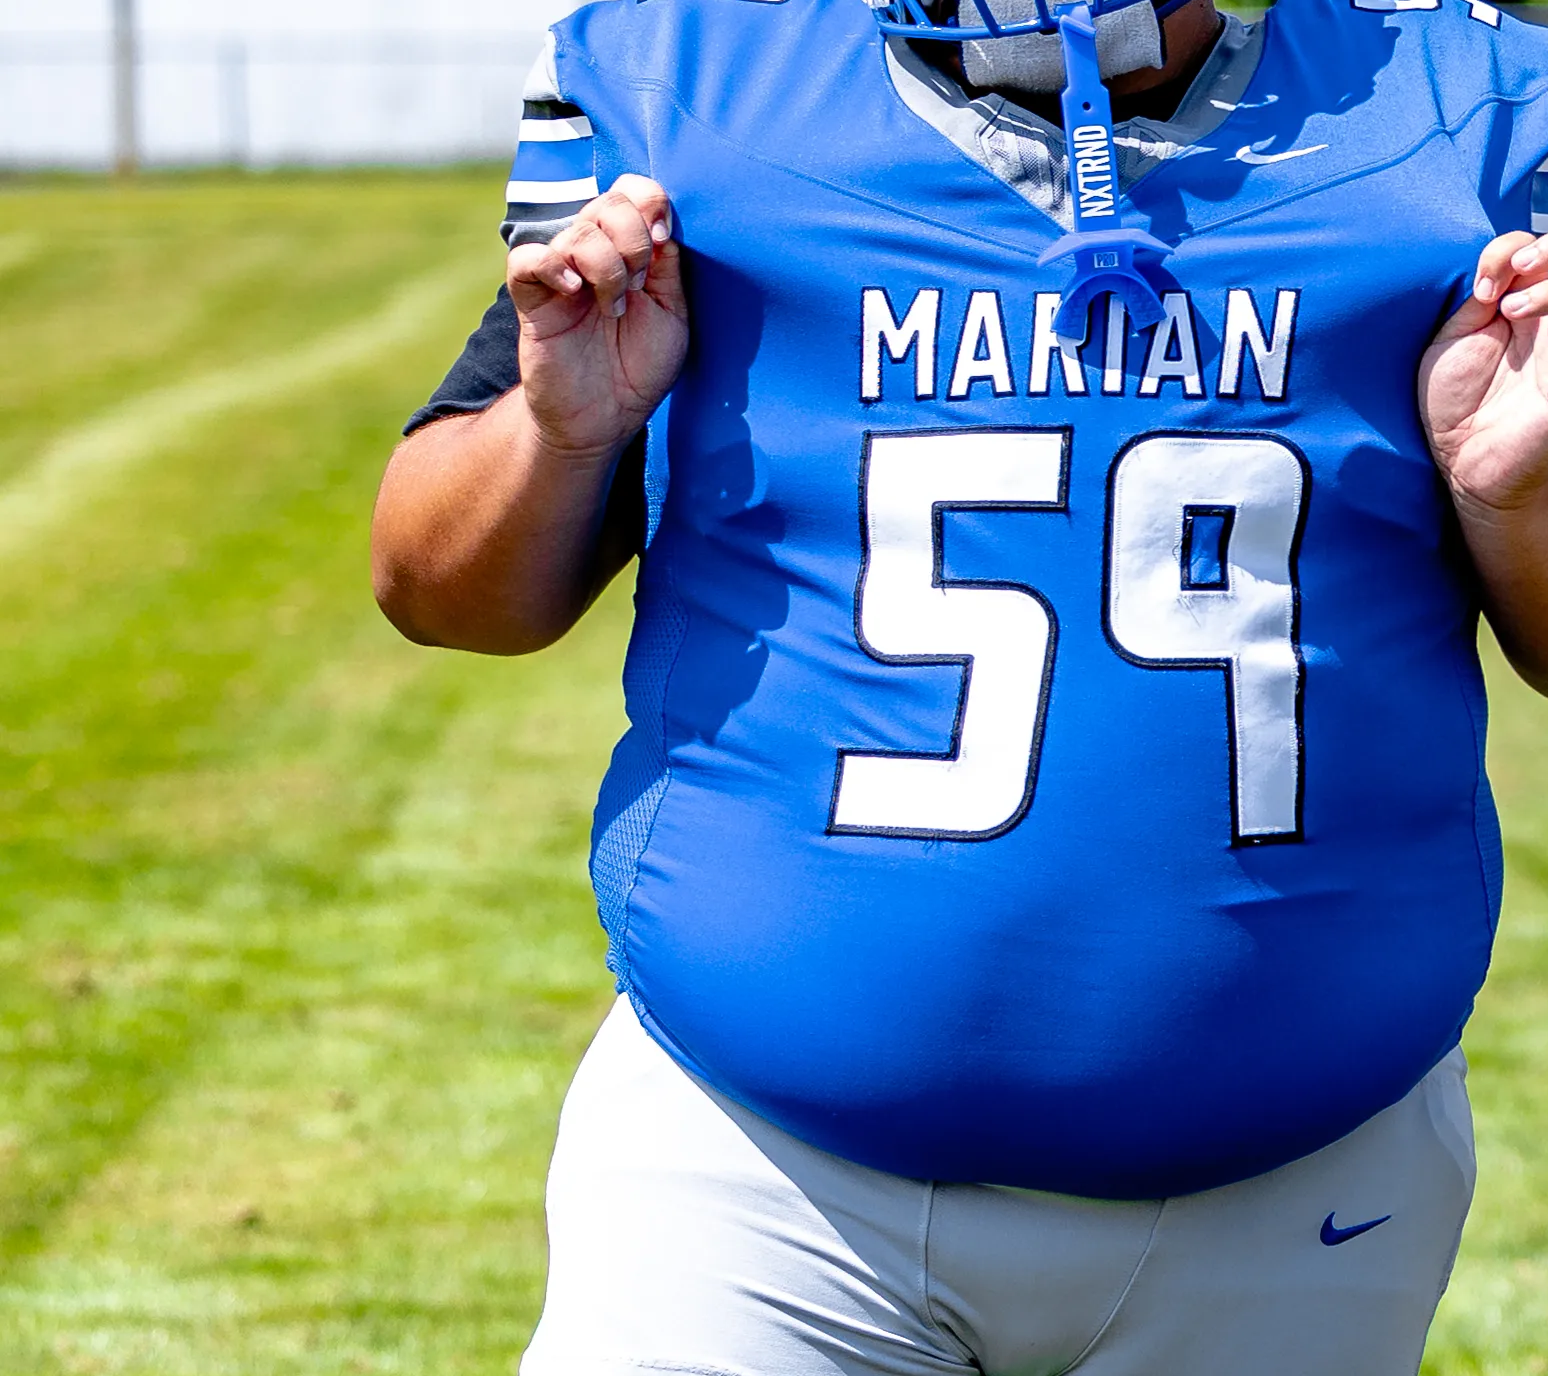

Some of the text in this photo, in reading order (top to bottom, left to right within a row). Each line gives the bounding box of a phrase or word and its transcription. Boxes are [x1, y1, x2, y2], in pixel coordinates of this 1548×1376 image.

[1073, 125, 1116, 219] NXTRND
[1096, 253, 1117, 267] PRO
[859, 285, 1302, 403] MARIAN
[826, 423, 1312, 848] 59
